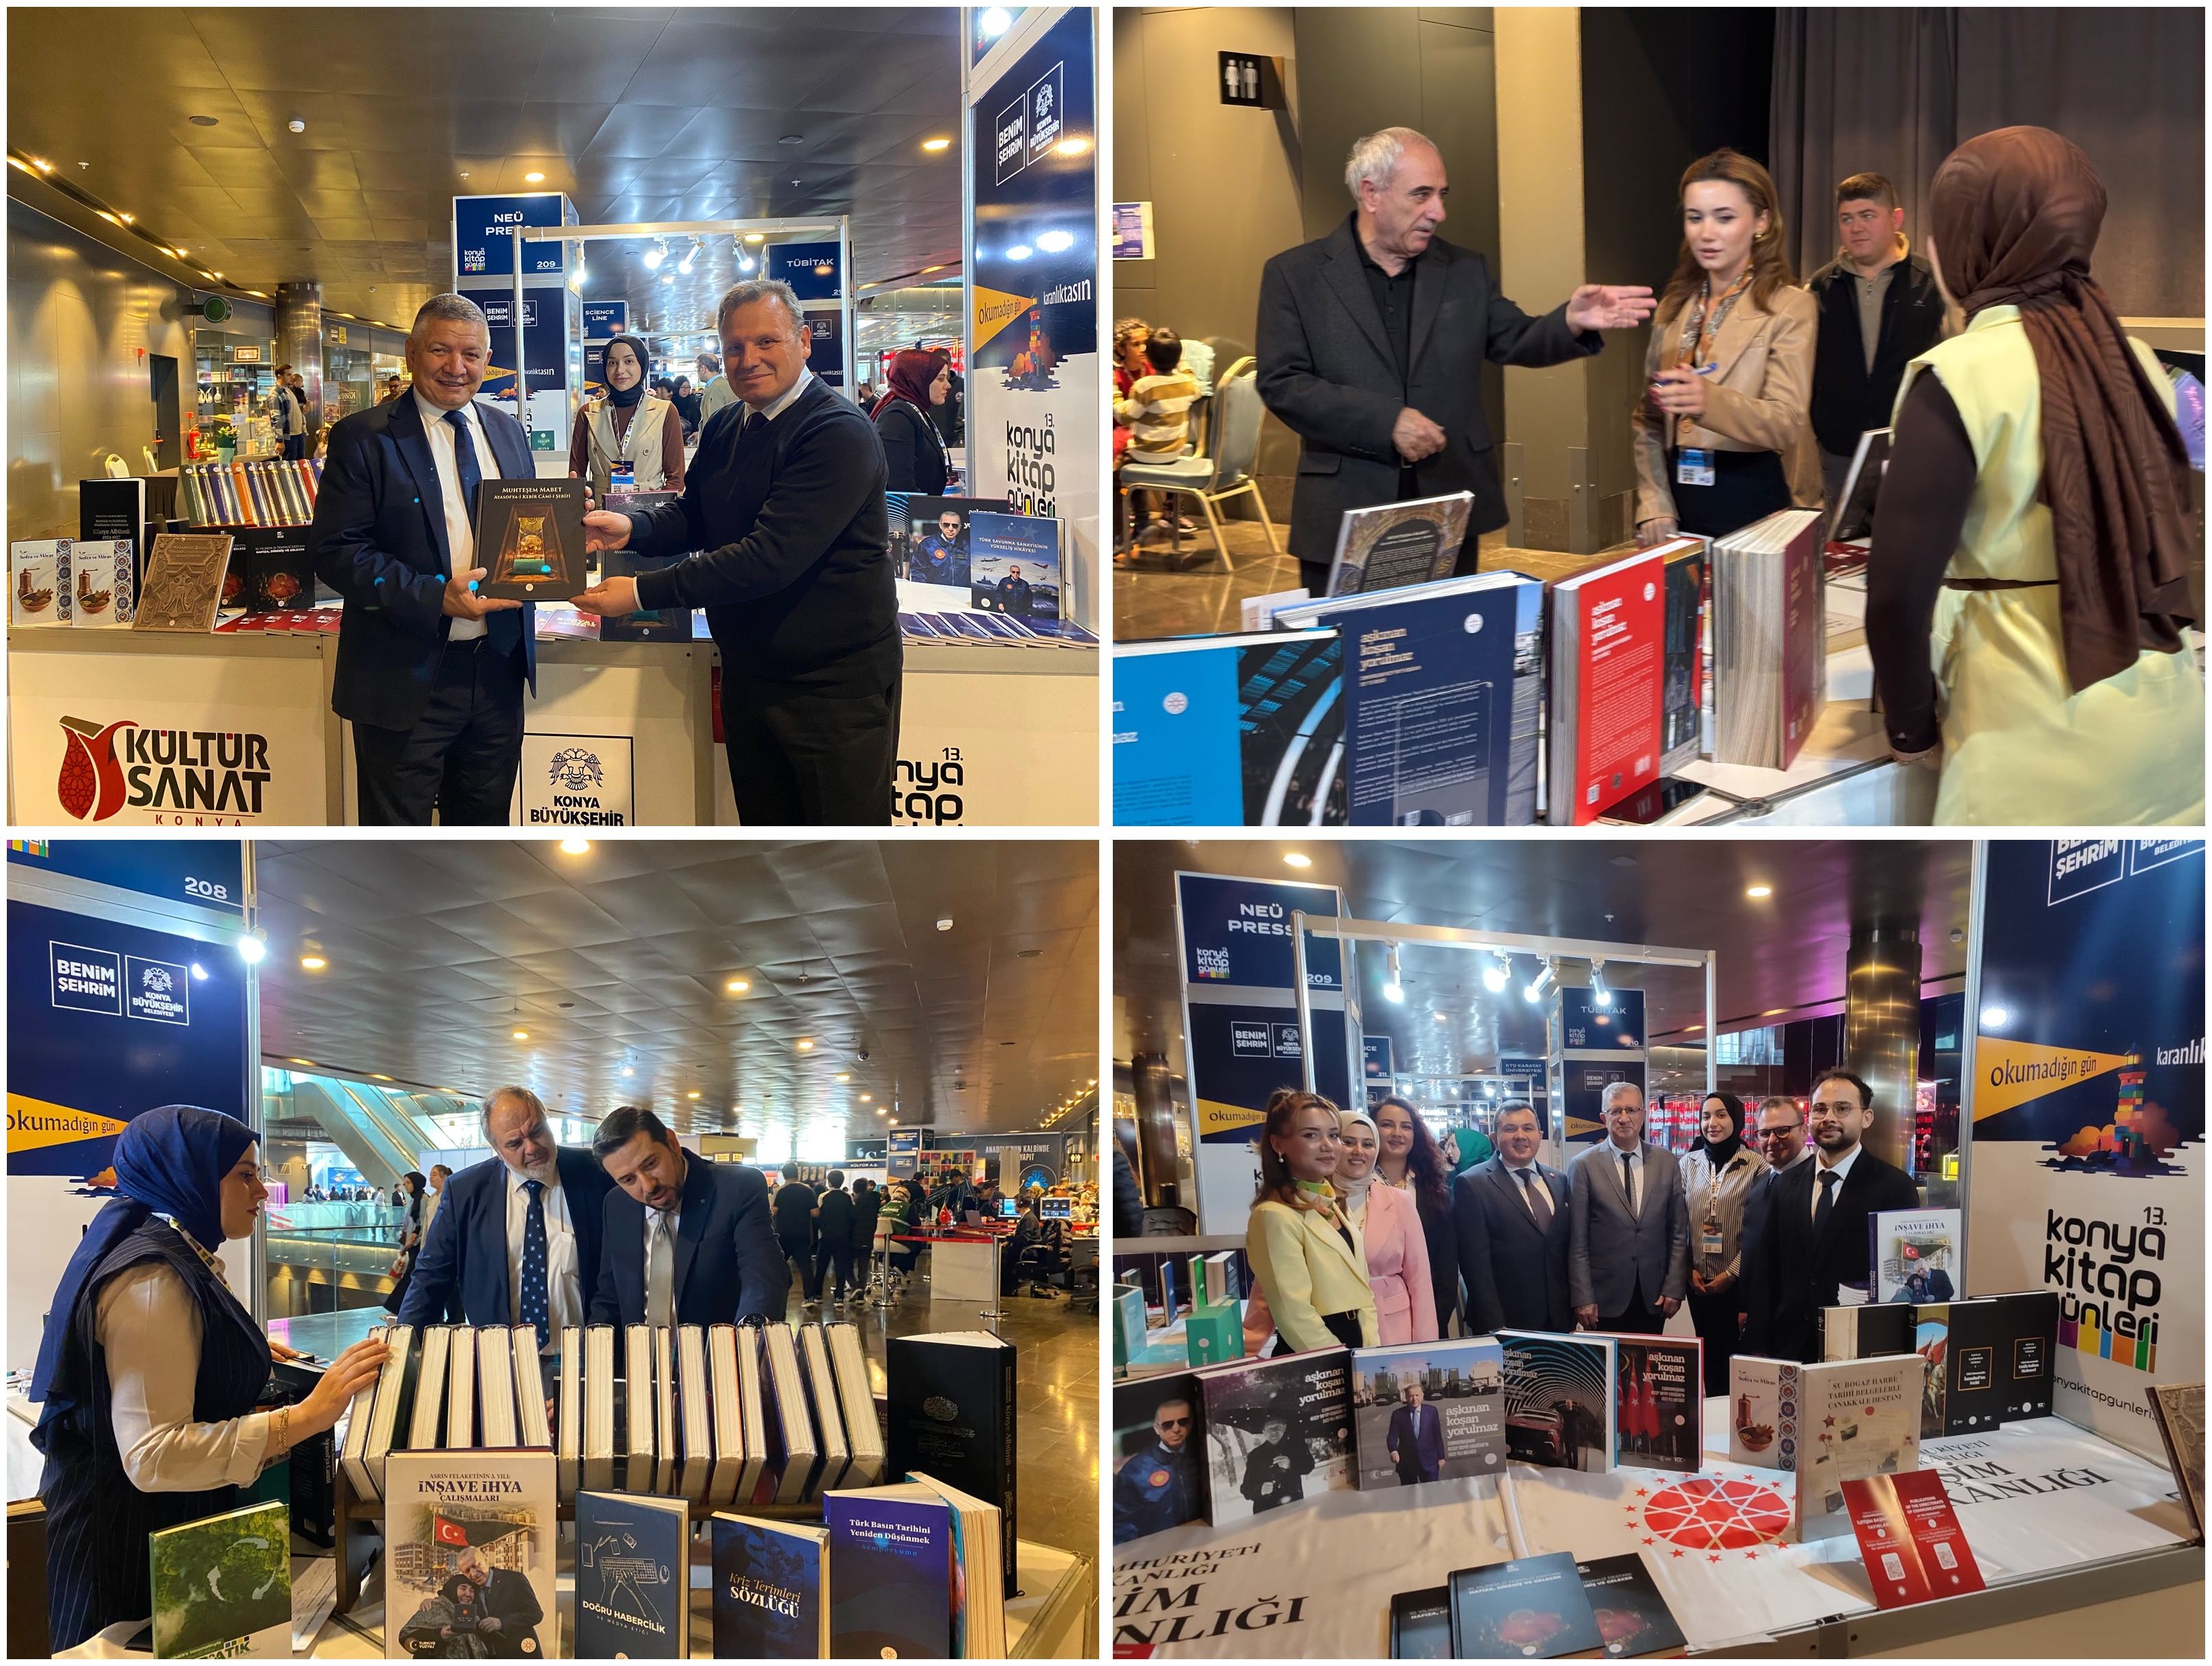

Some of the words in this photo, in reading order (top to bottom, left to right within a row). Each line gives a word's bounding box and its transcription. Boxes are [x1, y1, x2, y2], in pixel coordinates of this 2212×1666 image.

[1036, 115, 1052, 132] KONYA
[494, 211, 524, 223] NEÜ
[786, 258, 834, 268] TÜBİTAK
[1043, 279, 1092, 306] karanlıktasın
[978, 301, 1014, 325] okumadığın
[1044, 413, 1055, 427] 13.
[1006, 421, 1055, 460] konya
[1007, 449, 1055, 498] kitap
[1007, 488, 1055, 518] günleri
[1016, 541, 1048, 550] SANAYİSİNİN
[126, 727, 268, 771] KÜLTÜR
[941, 748, 963, 762] 13.
[894, 759, 963, 791] nya
[127, 767, 271, 813] SANAT
[553, 795, 600, 809] KONYA
[892, 785, 963, 825] tap
[155, 814, 242, 826] KONYA
[530, 807, 624, 826] BÜYÜKŞEHİR
[2056, 840, 2118, 880] ŞEHRİM
[184, 876, 228, 900] 208
[1240, 903, 1283, 918] NEÜ
[1197, 947, 1229, 958] konya
[57, 959, 115, 983] BENİM
[1197, 956, 1229, 969] kitap
[58, 976, 115, 998] ŞEHRİM
[1307, 974, 1332, 983] 209
[132, 997, 184, 1013] BÜYÜKŞEHİR
[145, 991, 171, 1002] KONYA
[143, 1007, 174, 1017] BELEDİYESİ
[1580, 1005, 1627, 1015] TÜBİTAK
[1990, 1056, 2077, 1087] okumadığın
[2080, 1056, 2097, 1075] gün
[7, 1110, 99, 1135] okumadığın
[102, 1120, 116, 1134] gün
[1209, 1110, 1261, 1122] okumadığın
[2143, 1206, 2168, 1226] 13.
[2046, 1209, 2166, 1264] konya
[2044, 1243, 2161, 1312] kitap
[2060, 1292, 2159, 1345] ünleri
[1648, 1353, 1685, 1364] aşkınan
[1305, 1367, 1344, 1384] aşkınan
[1658, 1362, 1685, 1374] koşan
[1316, 1376, 1345, 1392] koşan
[1642, 1372, 1685, 1383] yorulmaz
[1299, 1387, 1346, 1407] yorulmaz
[2052, 1375, 2155, 1421] onyakitapgunleri.
[1446, 1403, 1490, 1417] aşkınan
[1446, 1415, 1479, 1427] koşan
[1447, 1423, 1499, 1439] yorulmaz
[1938, 1461, 2016, 1487] ŞİM
[482, 1481, 523, 1493] İHYA
[1946, 1468, 2113, 1506] KANLIĞI
[440, 1495, 500, 1503] ÇALIŞMALARI
[849, 1519, 870, 1529] Türk
[871, 1520, 894, 1530] Basın
[895, 1523, 931, 1534] Tarihini
[850, 1529, 883, 1540] Yeniden
[884, 1531, 930, 1544] Düşünmek
[862, 1543, 918, 1557] Sempozyumu
[1113, 1542, 1262, 1573] MHURİYETİ
[729, 1572, 750, 1587] Kriz
[754, 1577, 802, 1603] Terimleri
[730, 1585, 799, 1619] SÖZLÜĞÜ
[583, 1599, 612, 1617] DOĞRU
[613, 1609, 666, 1635] HABERCİLİK
[607, 1618, 629, 1630] MEDYA
[1113, 1594, 1309, 1644] NLIĞI
